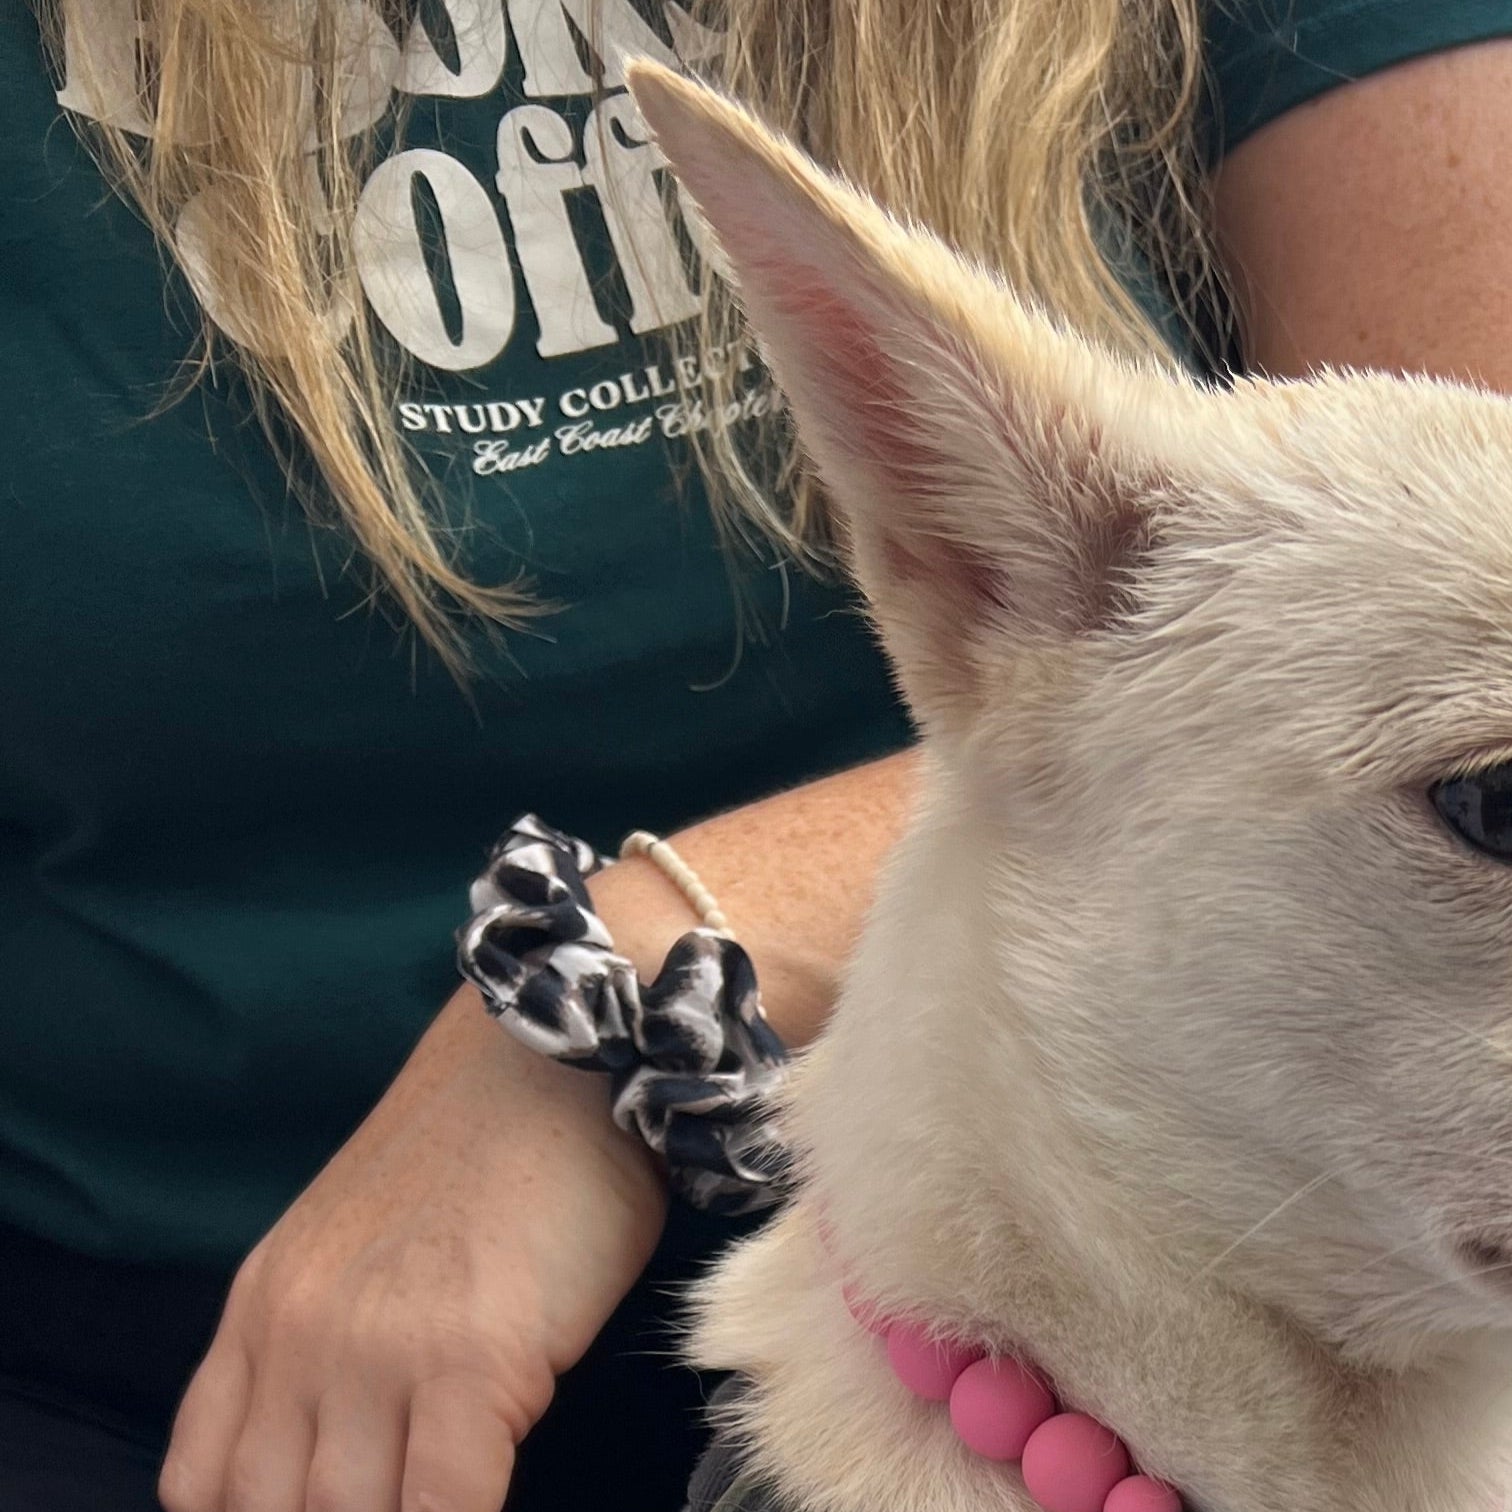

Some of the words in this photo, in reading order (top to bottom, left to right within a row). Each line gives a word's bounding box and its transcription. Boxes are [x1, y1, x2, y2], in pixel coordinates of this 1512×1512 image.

[398, 396, 547, 434] STUDY
[472, 439, 552, 476] East
[553, 419, 654, 456] Coast
